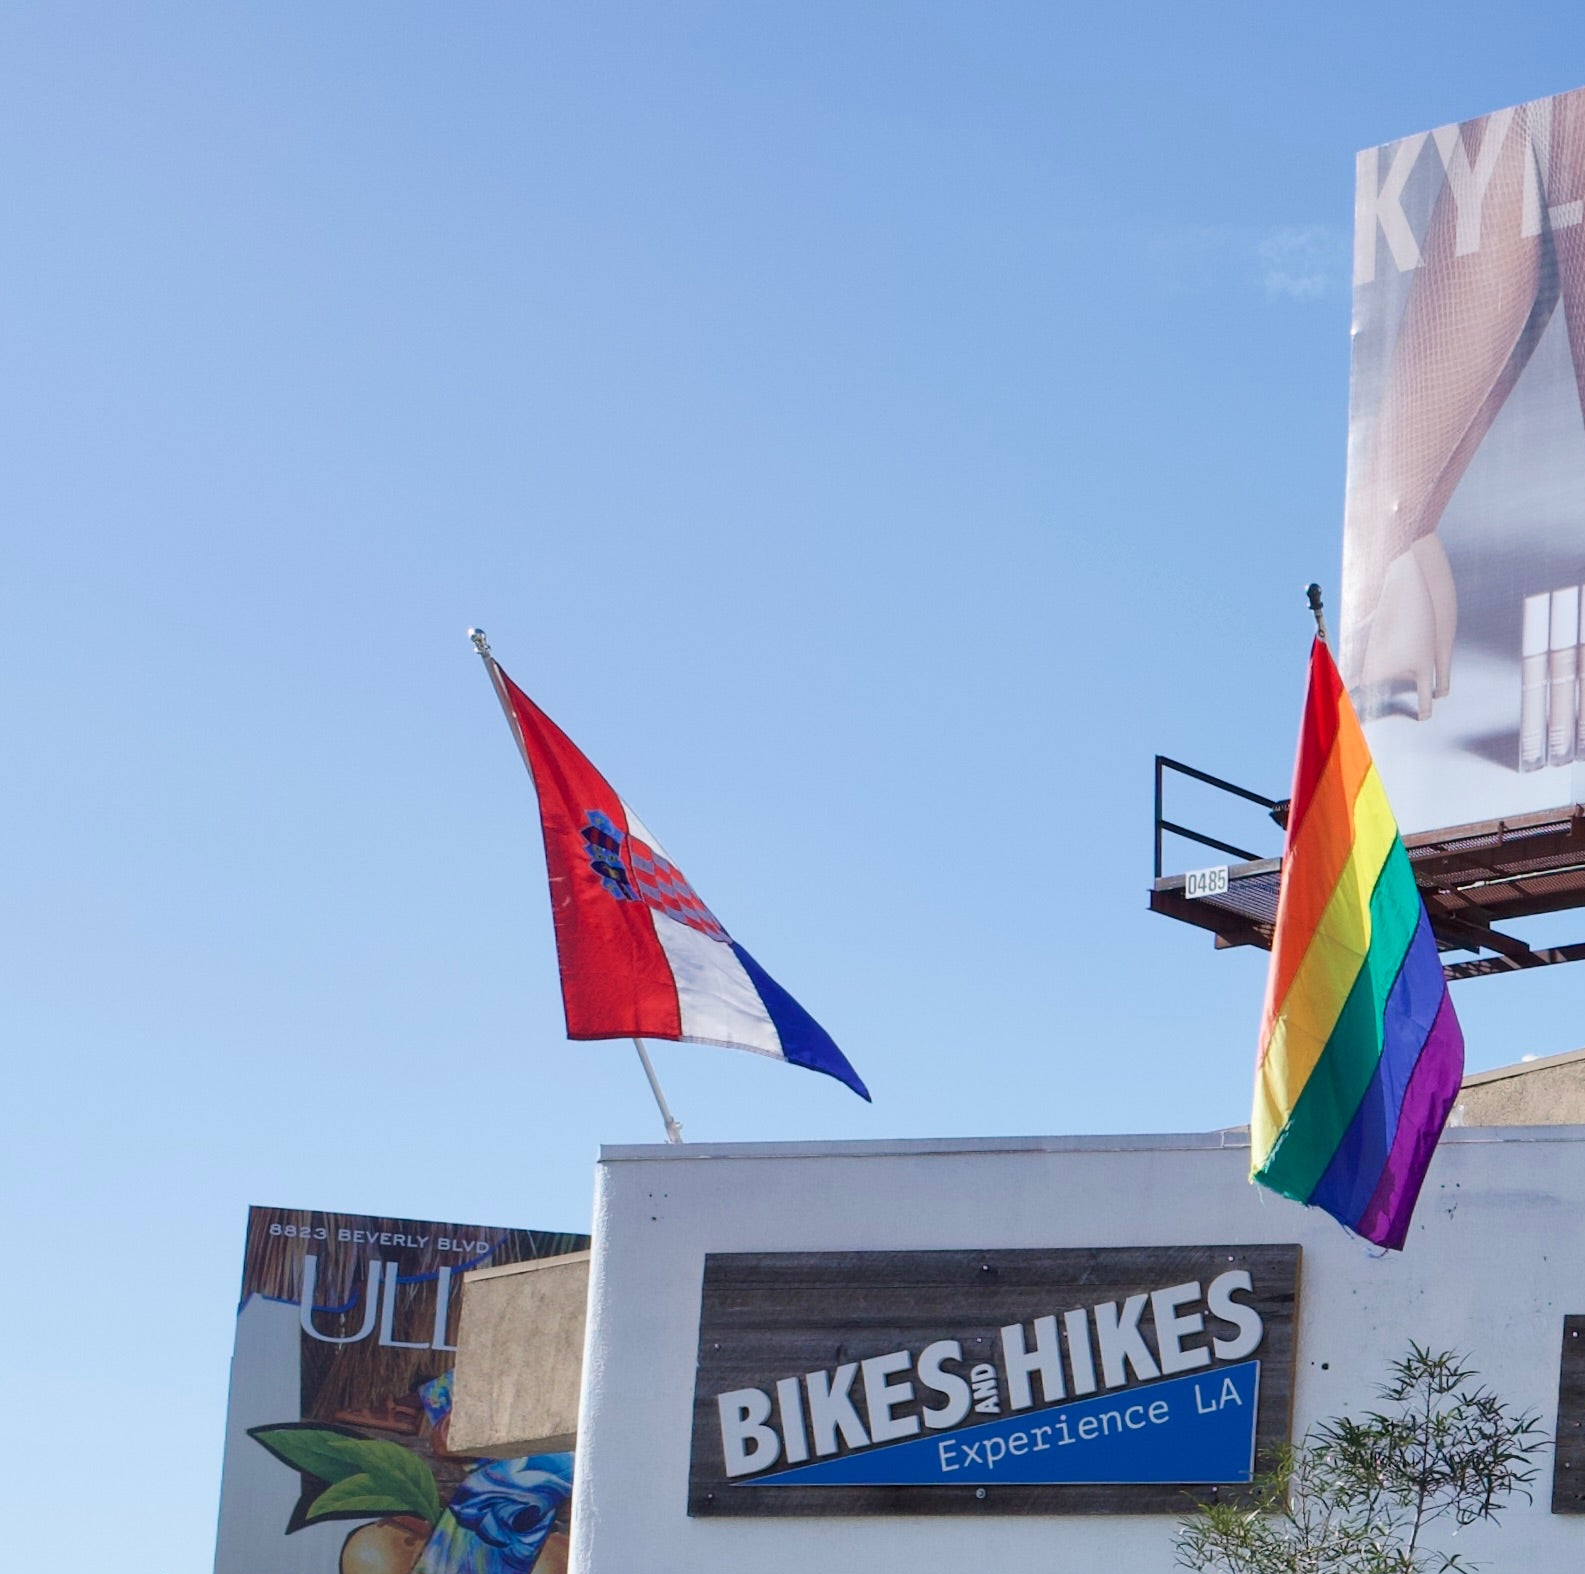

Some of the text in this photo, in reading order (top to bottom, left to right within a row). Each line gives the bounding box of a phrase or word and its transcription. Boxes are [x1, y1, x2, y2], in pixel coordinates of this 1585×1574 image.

[1187, 868, 1227, 896] 0485
[269, 1224, 490, 1254] 8823 BEVERLY BLVD
[718, 1270, 1264, 1477] BIKES AND HIKES
[938, 1377, 1243, 1472] Experience LA
